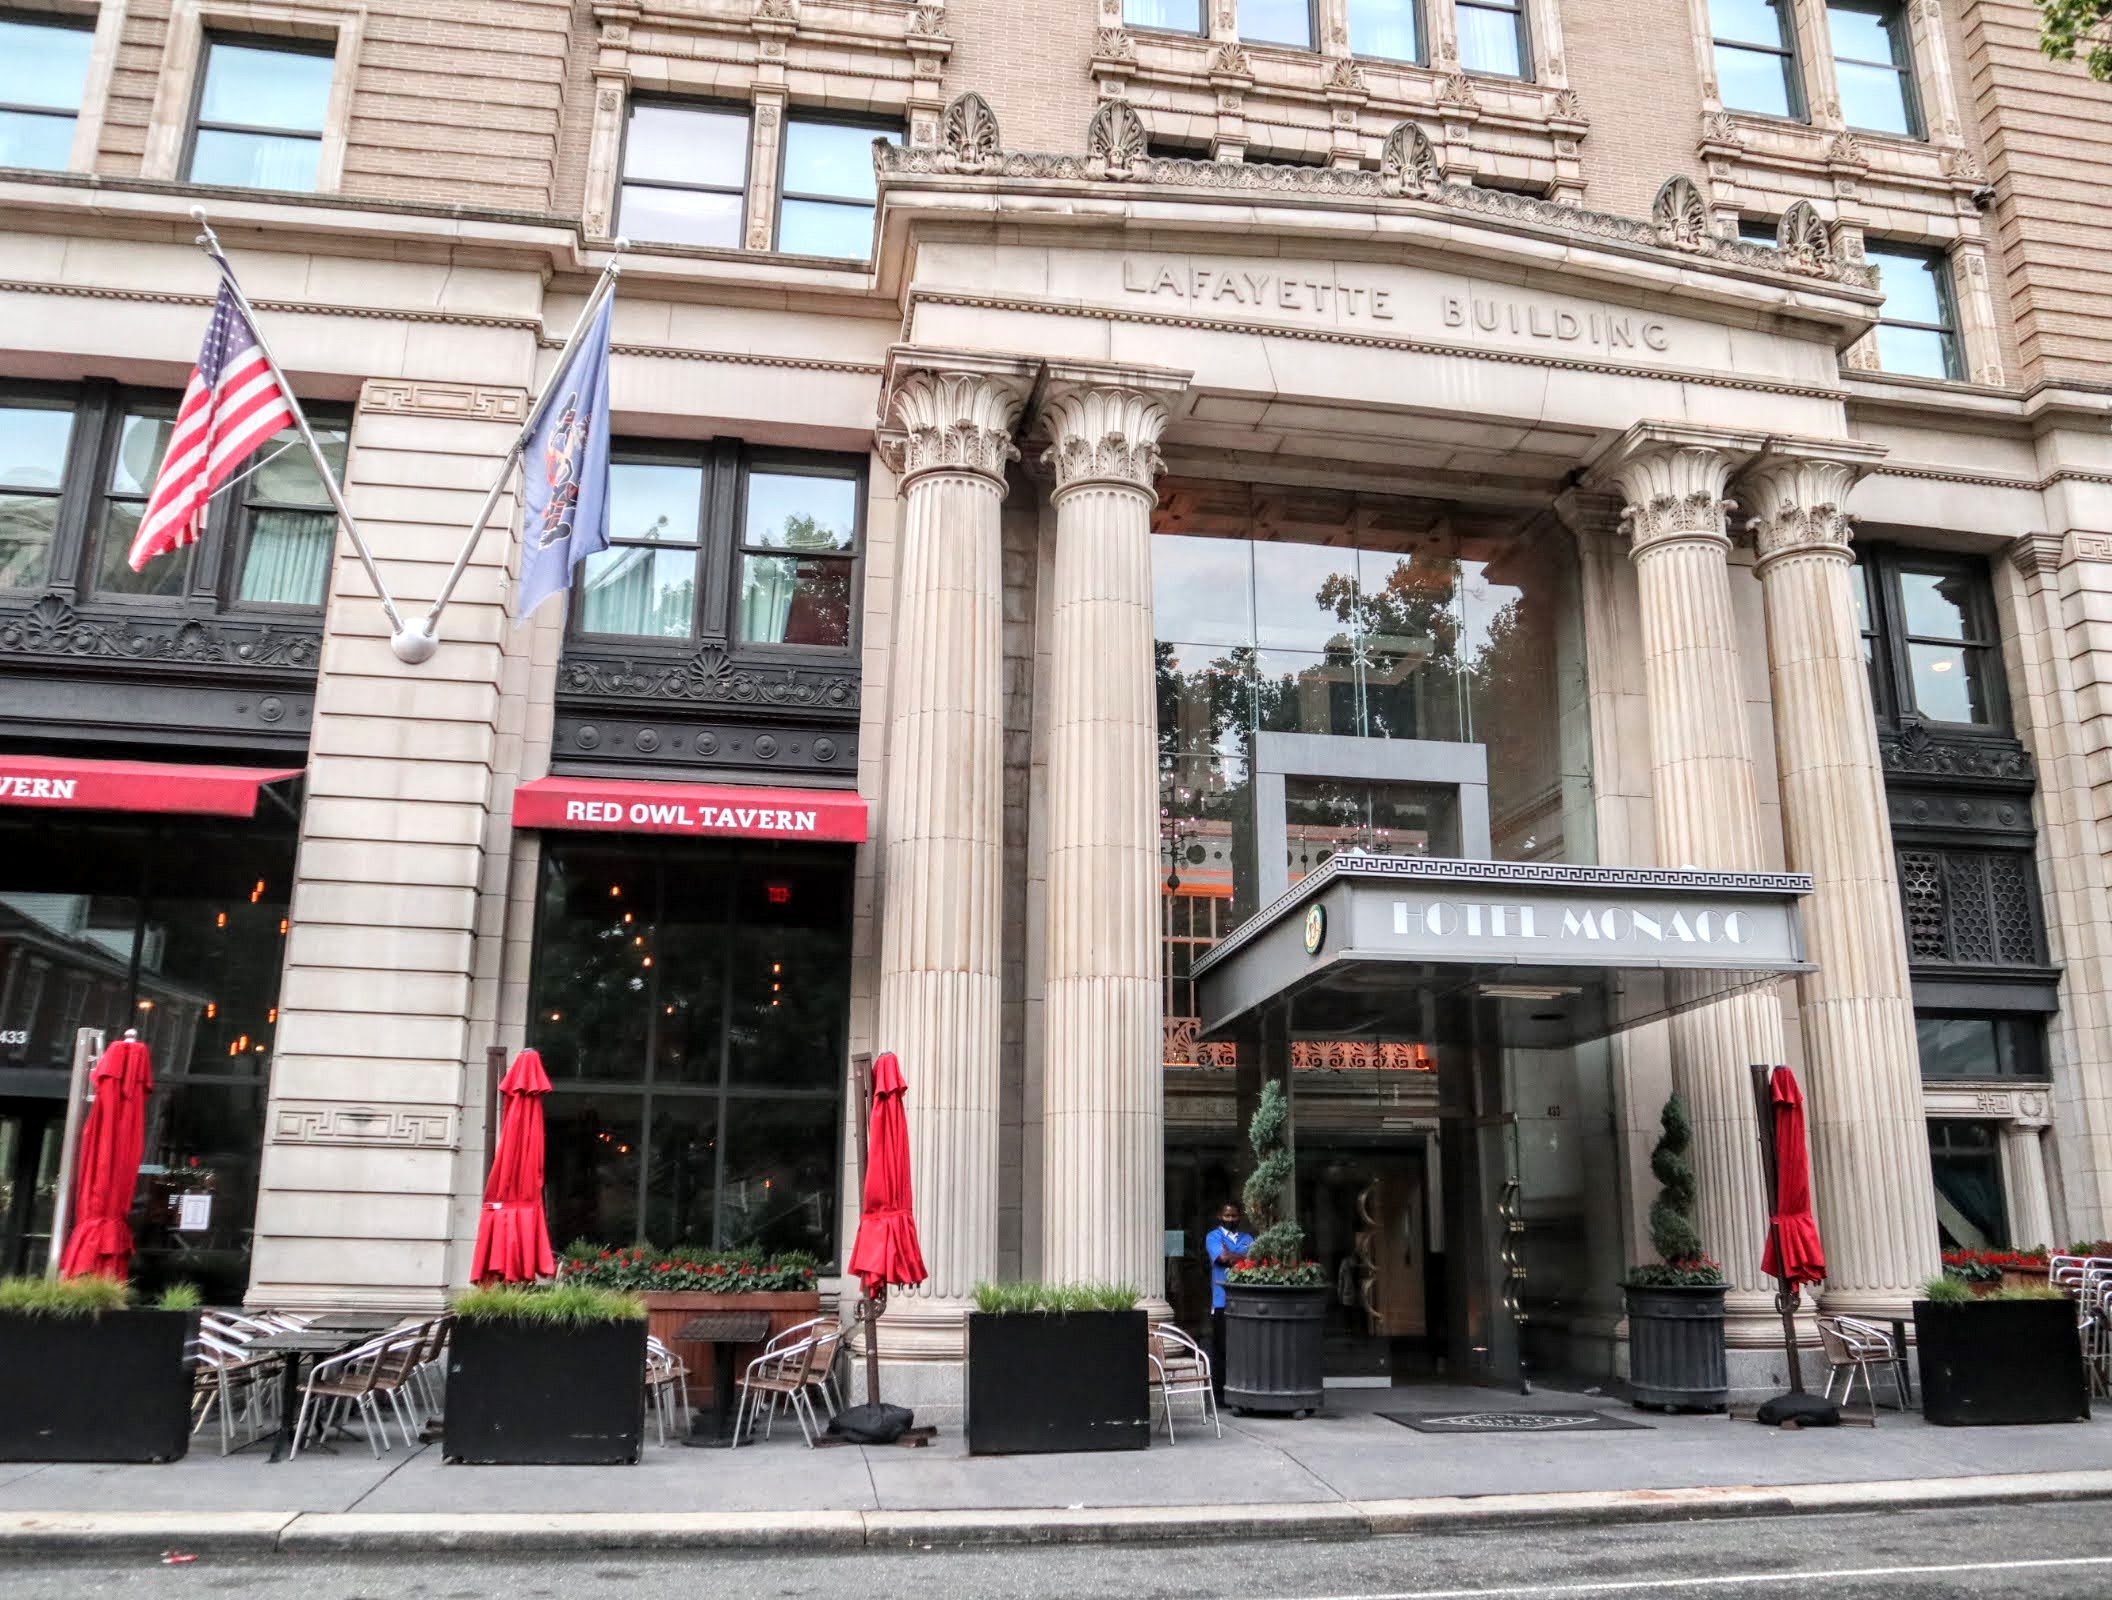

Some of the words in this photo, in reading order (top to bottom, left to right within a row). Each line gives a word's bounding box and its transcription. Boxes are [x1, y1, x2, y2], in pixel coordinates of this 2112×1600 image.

[1124, 259, 1393, 319] LAFAYETTE
[1443, 295, 1669, 351] BUILDING
[566, 801, 623, 823] RED
[629, 804, 694, 825] OWL
[698, 806, 817, 831] TAVERN
[1393, 901, 1549, 938] HOTEL
[1561, 907, 1755, 944] MONACO
[0, 1030, 26, 1044] 433
